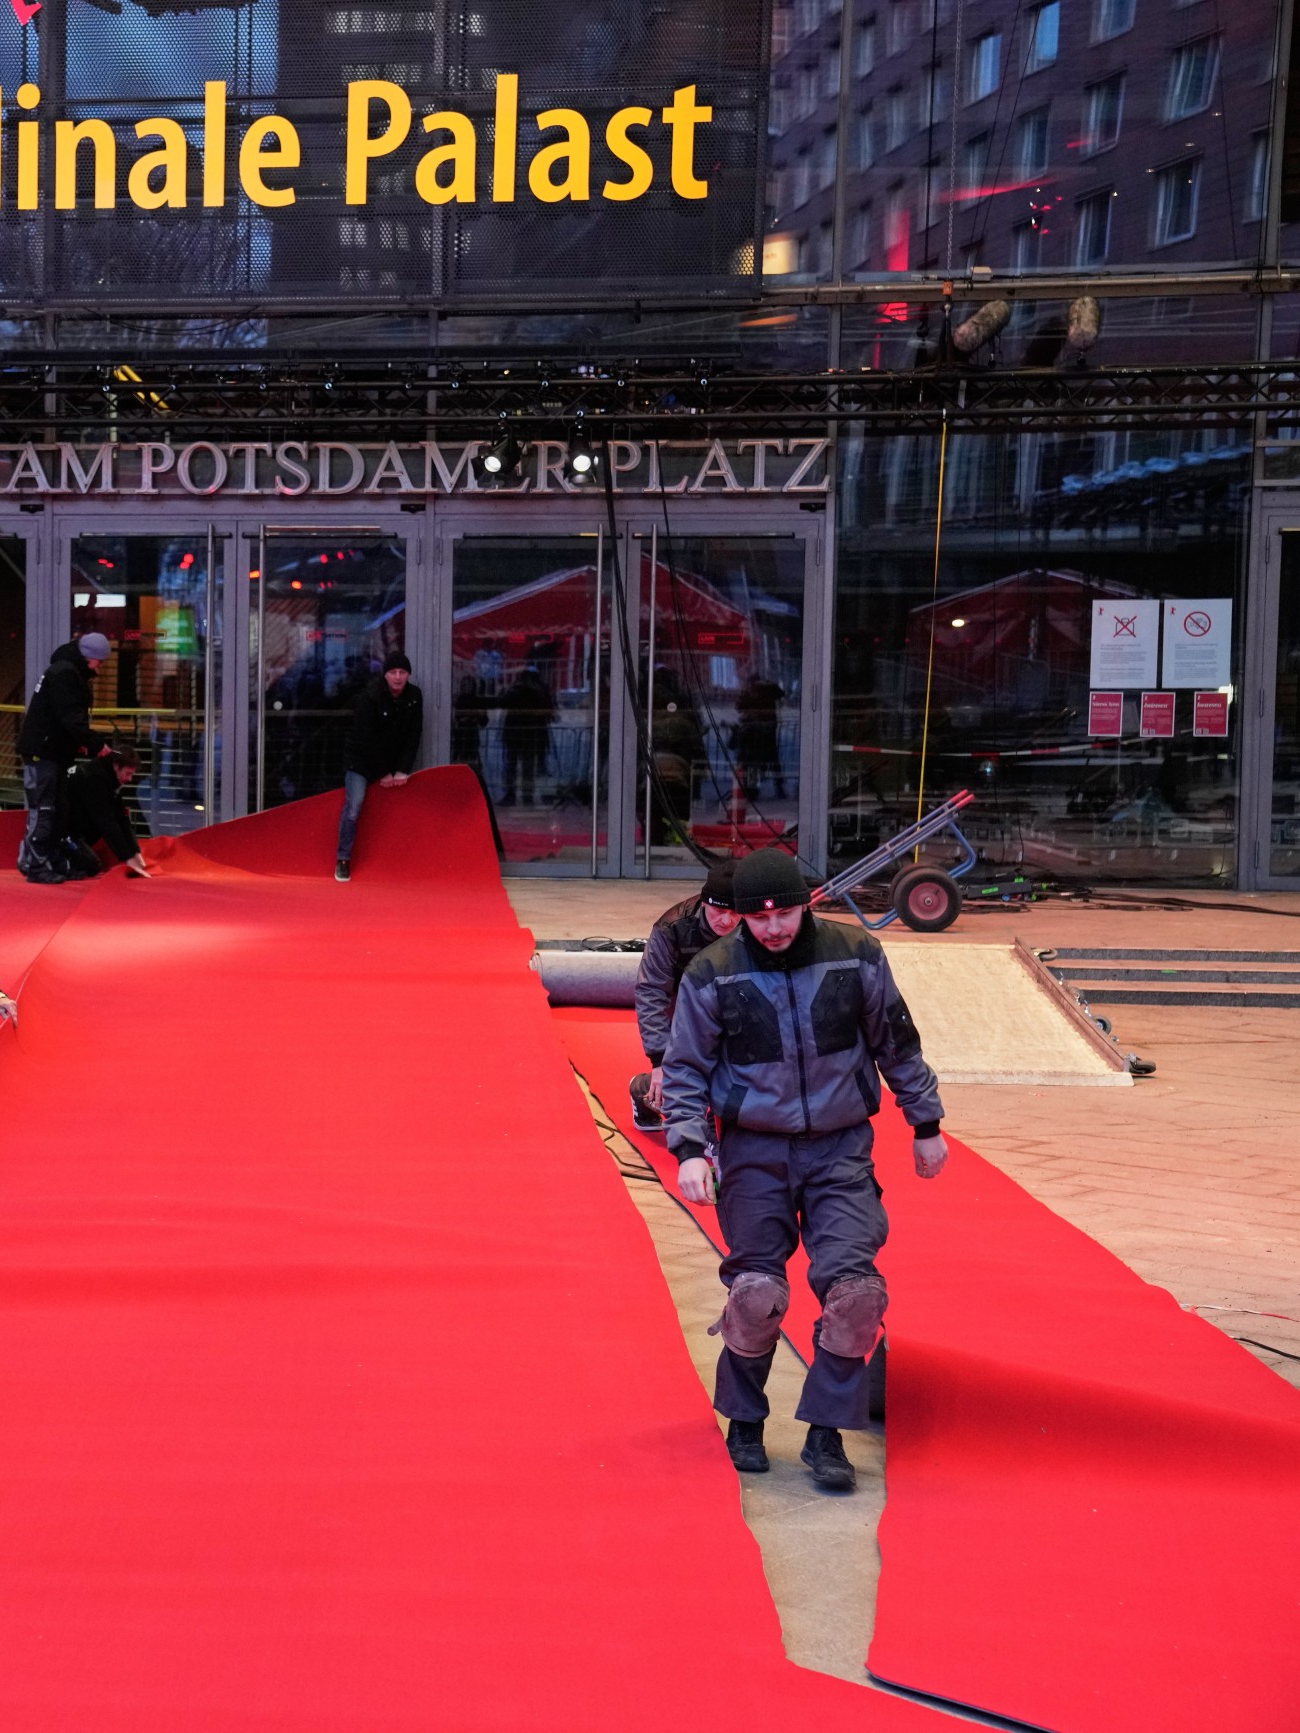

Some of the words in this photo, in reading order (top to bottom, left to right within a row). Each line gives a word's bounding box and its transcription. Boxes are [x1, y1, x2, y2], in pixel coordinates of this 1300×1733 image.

[347, 73, 712, 204] Palast
[5, 440, 119, 494] AM
[595, 438, 831, 493] PLATZ
